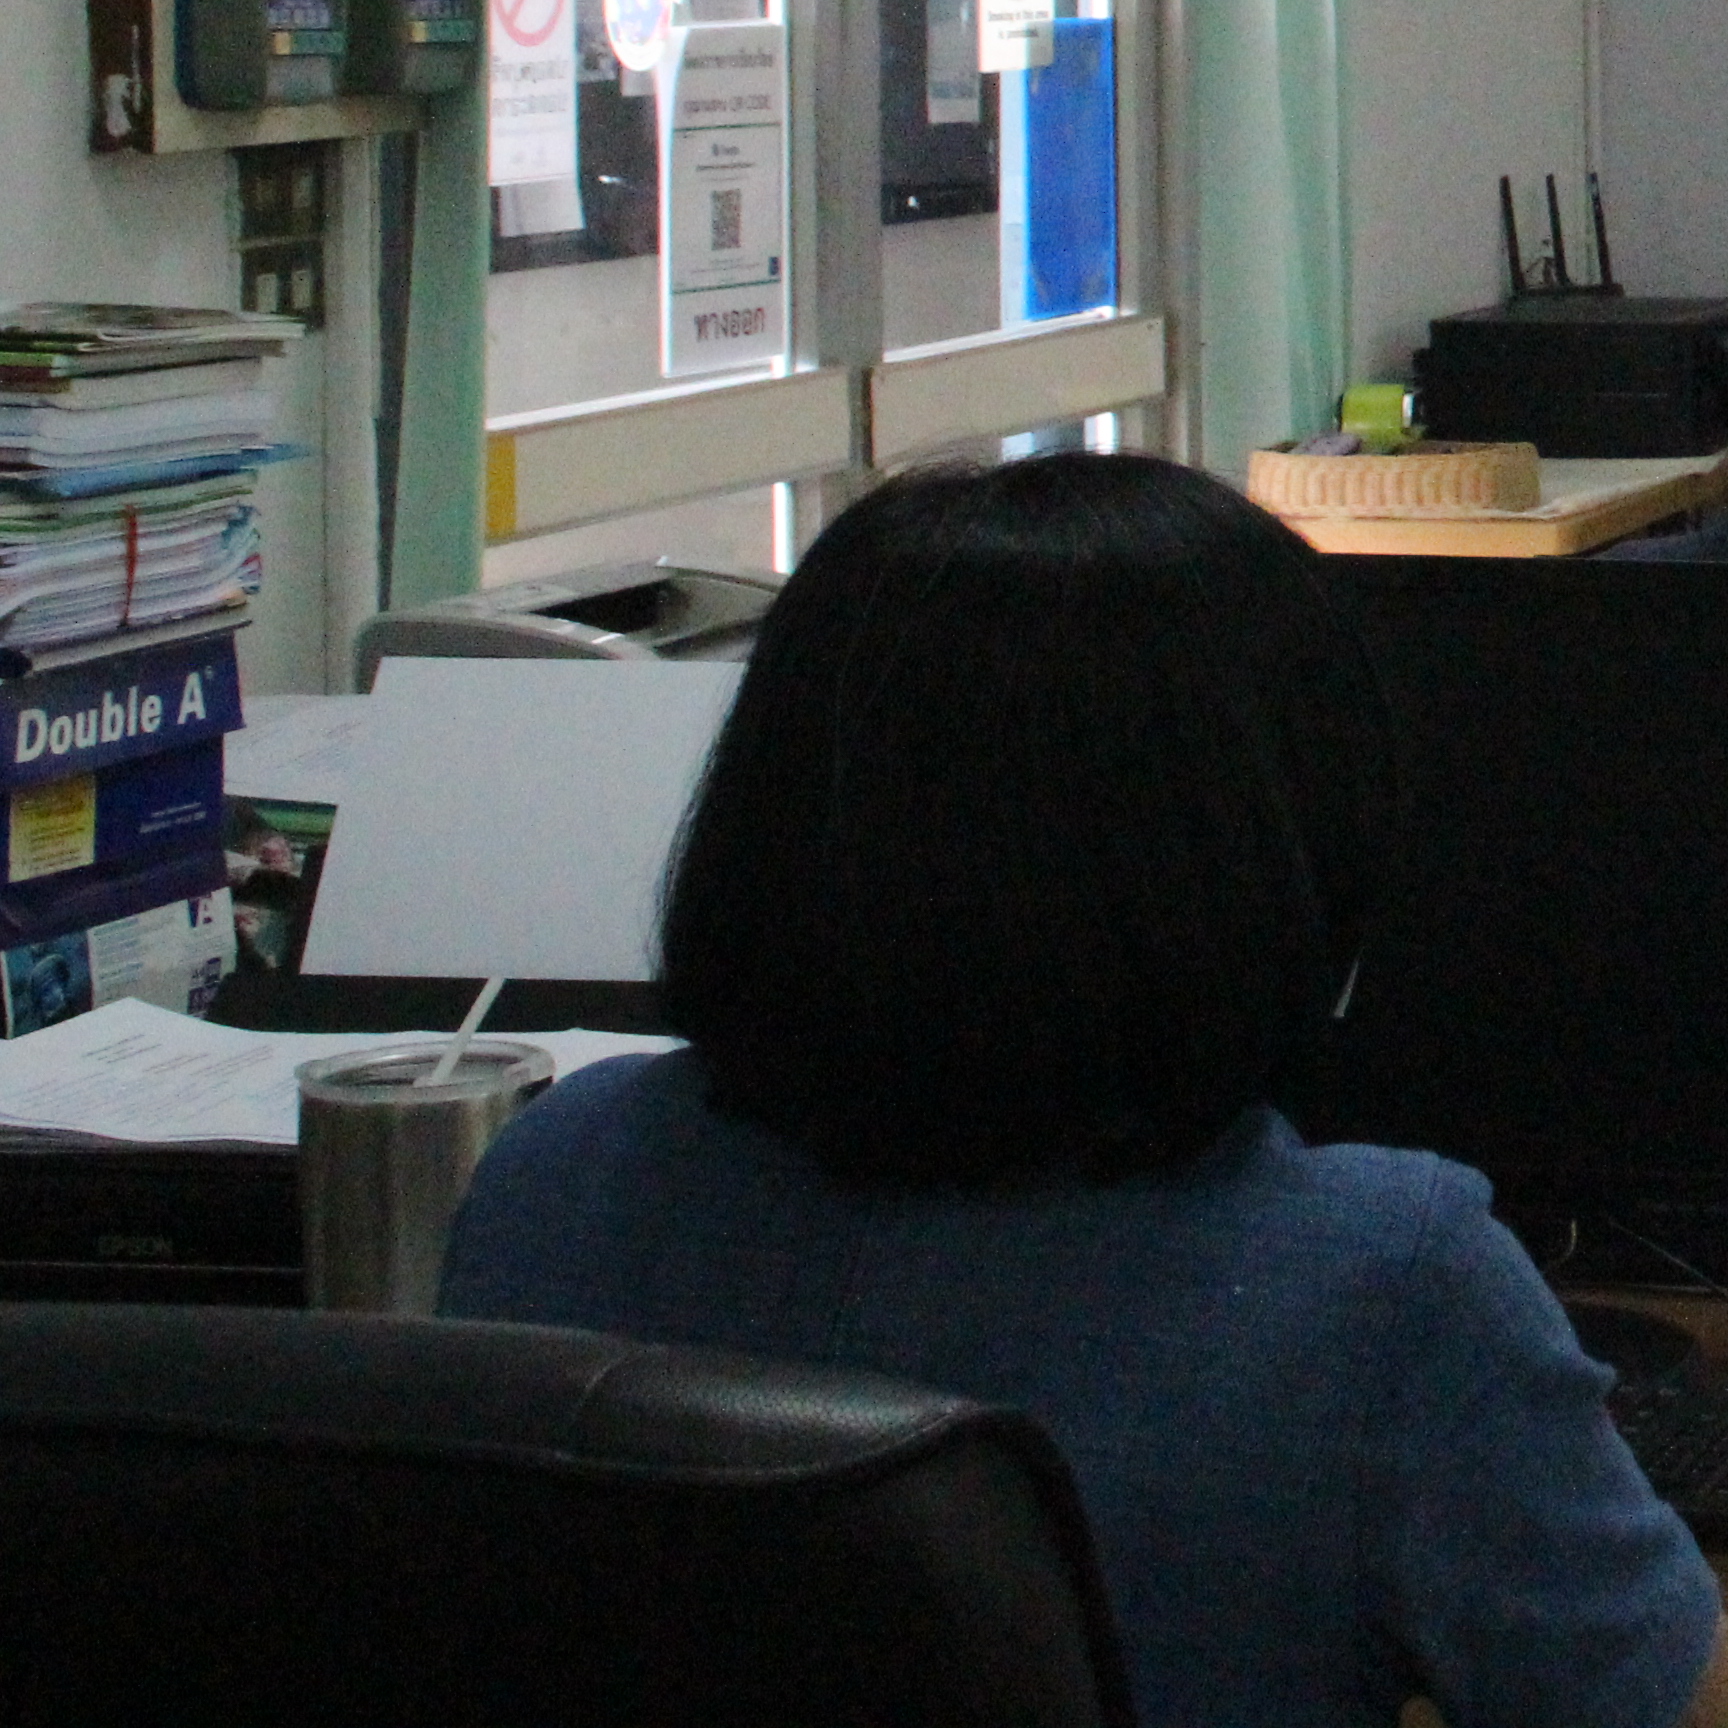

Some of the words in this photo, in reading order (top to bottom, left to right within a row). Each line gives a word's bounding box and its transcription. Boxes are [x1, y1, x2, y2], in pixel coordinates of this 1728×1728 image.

[694, 306, 766, 344] ทางออก
[14, 685, 164, 763] Double
[176, 671, 208, 726] A
